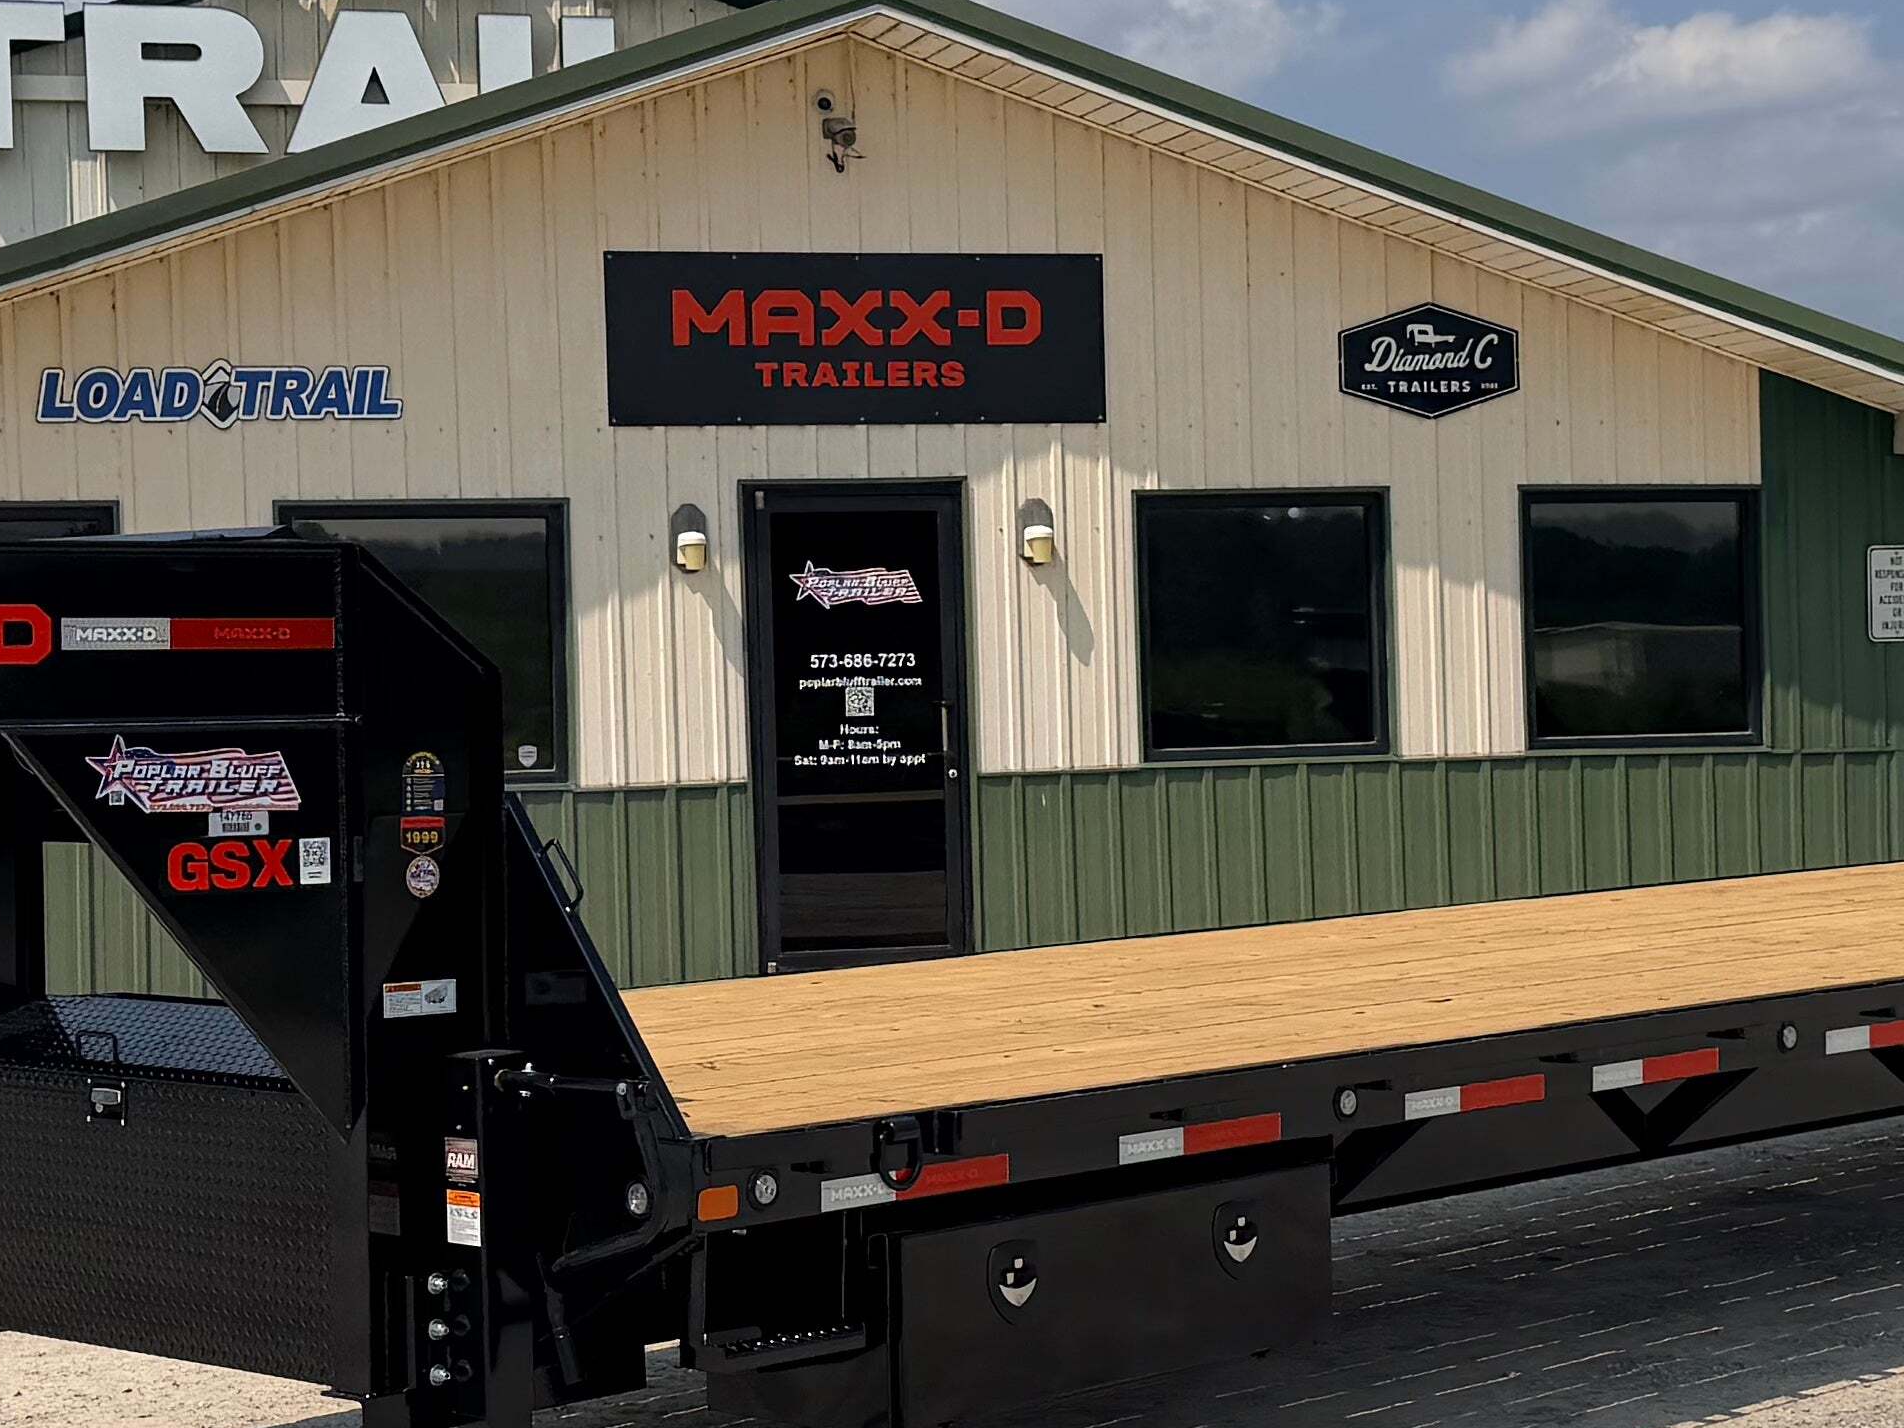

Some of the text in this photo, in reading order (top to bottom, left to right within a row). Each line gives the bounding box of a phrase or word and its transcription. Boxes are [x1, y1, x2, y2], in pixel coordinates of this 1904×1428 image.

[671, 289, 1043, 347] MAXX-D
[1364, 333, 1499, 372] Diamond C
[754, 361, 966, 388] TRAILERS
[37, 366, 403, 422] LOAD TRAIL
[1387, 380, 1471, 393] TRAILERS
[76, 627, 157, 641] MAXX-D
[810, 653, 916, 669] 573-686-7273
[114, 759, 282, 778] POPLAR BLUFF
[147, 779, 279, 793] TRAILER
[167, 839, 293, 892] GSX
[447, 1152, 475, 1169] RAM
